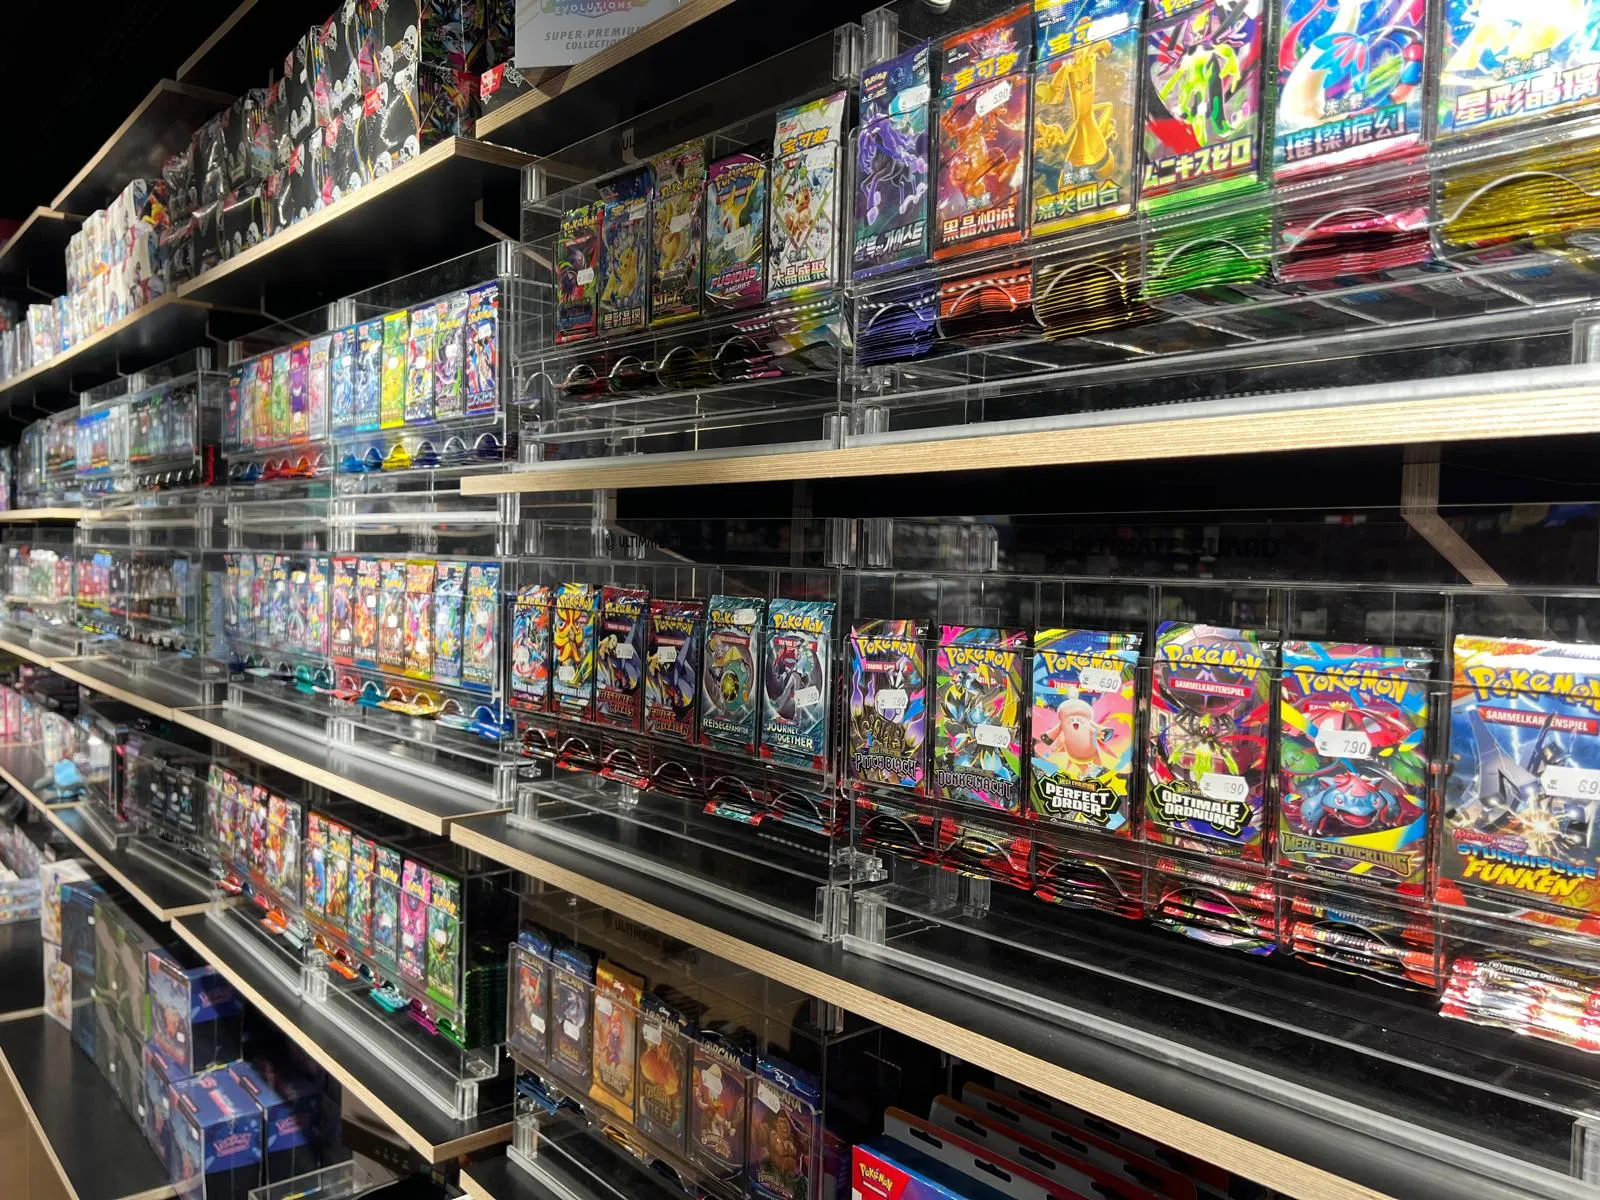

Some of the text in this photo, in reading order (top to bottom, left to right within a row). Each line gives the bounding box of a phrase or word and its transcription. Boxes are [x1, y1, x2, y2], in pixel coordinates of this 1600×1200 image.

[555, 1, 633, 15] EVOLUTIONS
[954, 51, 1019, 92] 宝可梦
[1142, 136, 1252, 190] ムニキスゼロ
[710, 267, 757, 289] FUSIONS
[1174, 679, 1246, 697] SAMMELKARTENSPIEL
[766, 722, 800, 735] JOURNEY
[1485, 710, 1589, 732] SAMMELKARENSPIEL
[774, 733, 814, 749] TOGETHER
[1046, 782, 1110, 805] PERFECT
[1161, 790, 1240, 818] OPTIMALE
[1052, 796, 1102, 817] ORDER
[1164, 803, 1236, 830] ORDNUNG
[1462, 856, 1585, 897] FUNKEN
[859, 1162, 893, 1192] Pokémon
